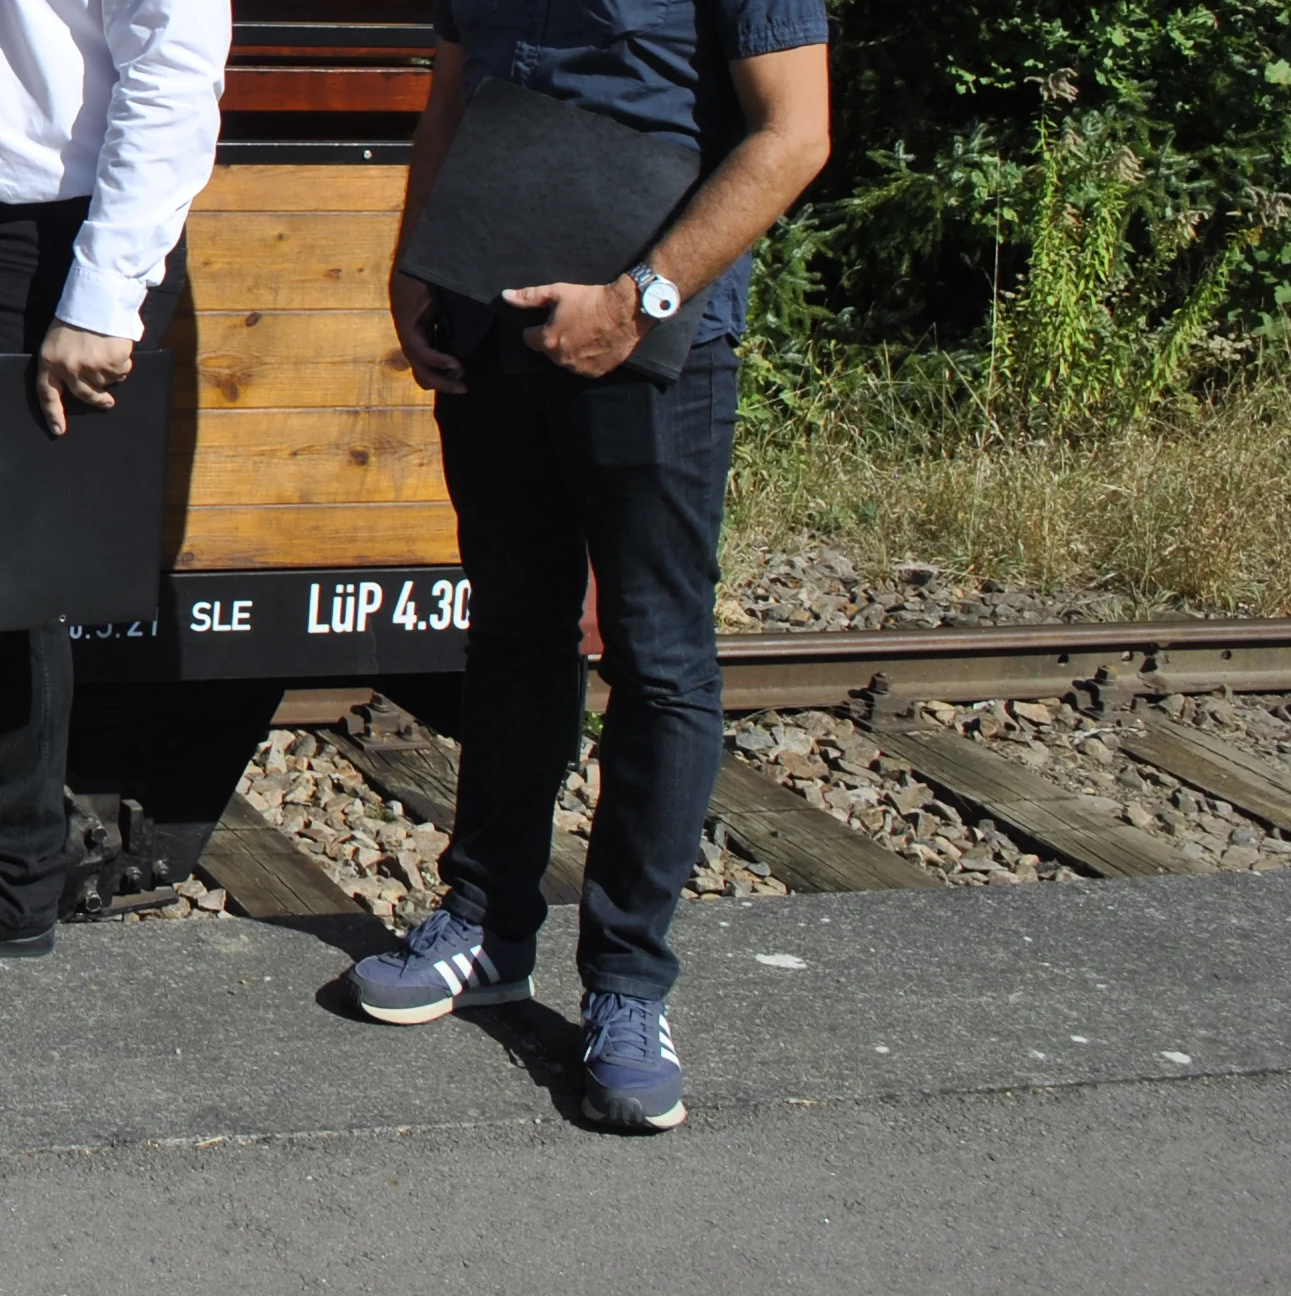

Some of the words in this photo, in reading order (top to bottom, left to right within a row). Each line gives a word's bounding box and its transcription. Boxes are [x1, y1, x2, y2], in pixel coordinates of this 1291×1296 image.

[190, 600, 253, 633] SLE
[307, 581, 384, 634] LüP
[392, 578, 472, 631] 4.30
